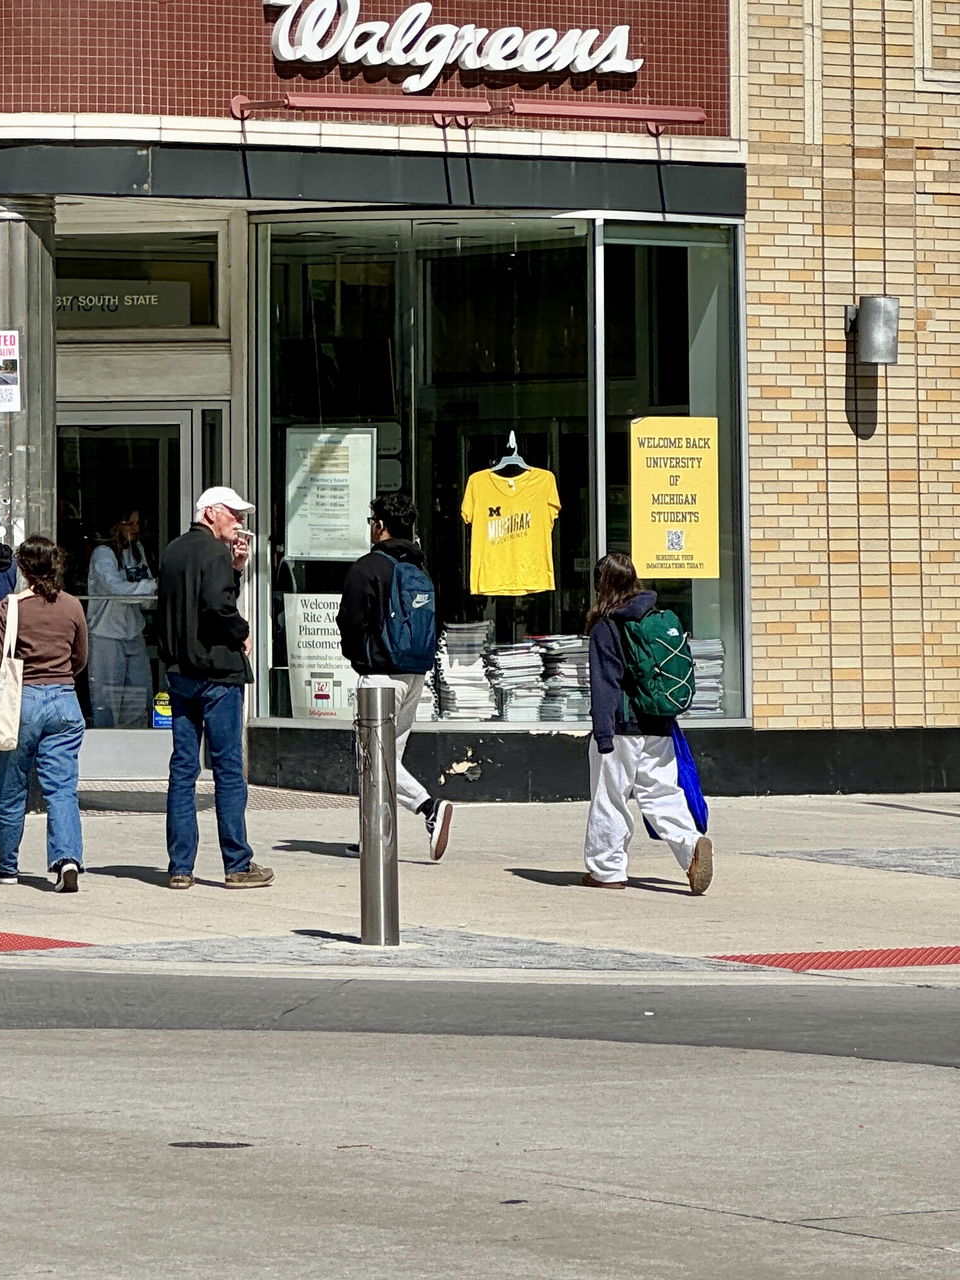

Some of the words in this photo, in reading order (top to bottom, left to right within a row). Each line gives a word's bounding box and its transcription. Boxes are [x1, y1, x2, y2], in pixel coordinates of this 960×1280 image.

[78, 295, 119, 306] SOUTH
[124, 294, 159, 305] STATE
[637, 437, 683, 449] WELCOME
[685, 437, 711, 449] BACK
[646, 457, 703, 469] UNIVERSITY
[669, 475, 681, 487] OF
[651, 493, 697, 505] MICHIGAN
[488, 506, 501, 517] M
[650, 511, 700, 523] STUDENTS
[303, 612, 322, 623] Rite
[324, 612, 336, 623] Ai
[298, 624, 341, 636] Pharmac
[297, 638, 341, 650] customer
